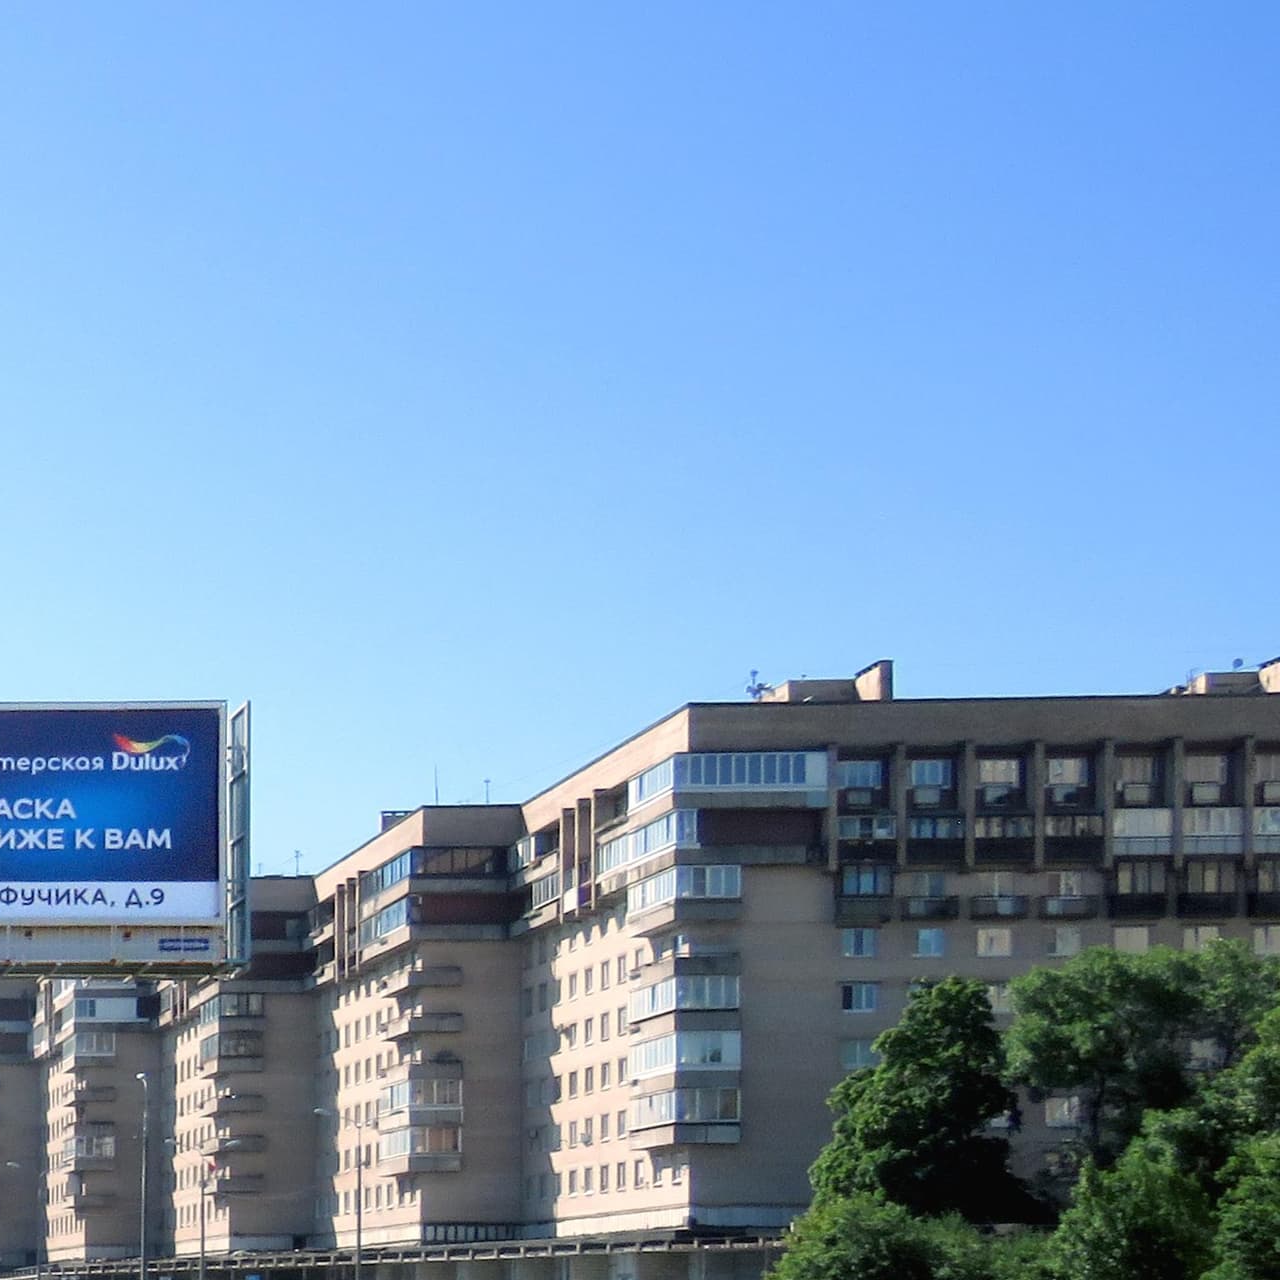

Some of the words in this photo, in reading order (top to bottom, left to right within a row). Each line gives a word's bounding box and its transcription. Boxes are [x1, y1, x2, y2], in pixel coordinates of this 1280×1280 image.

[111, 751, 180, 771] Dulux
[74, 828, 95, 850] К
[103, 828, 173, 850] ВАМ
[125, 887, 165, 908] Д.9
